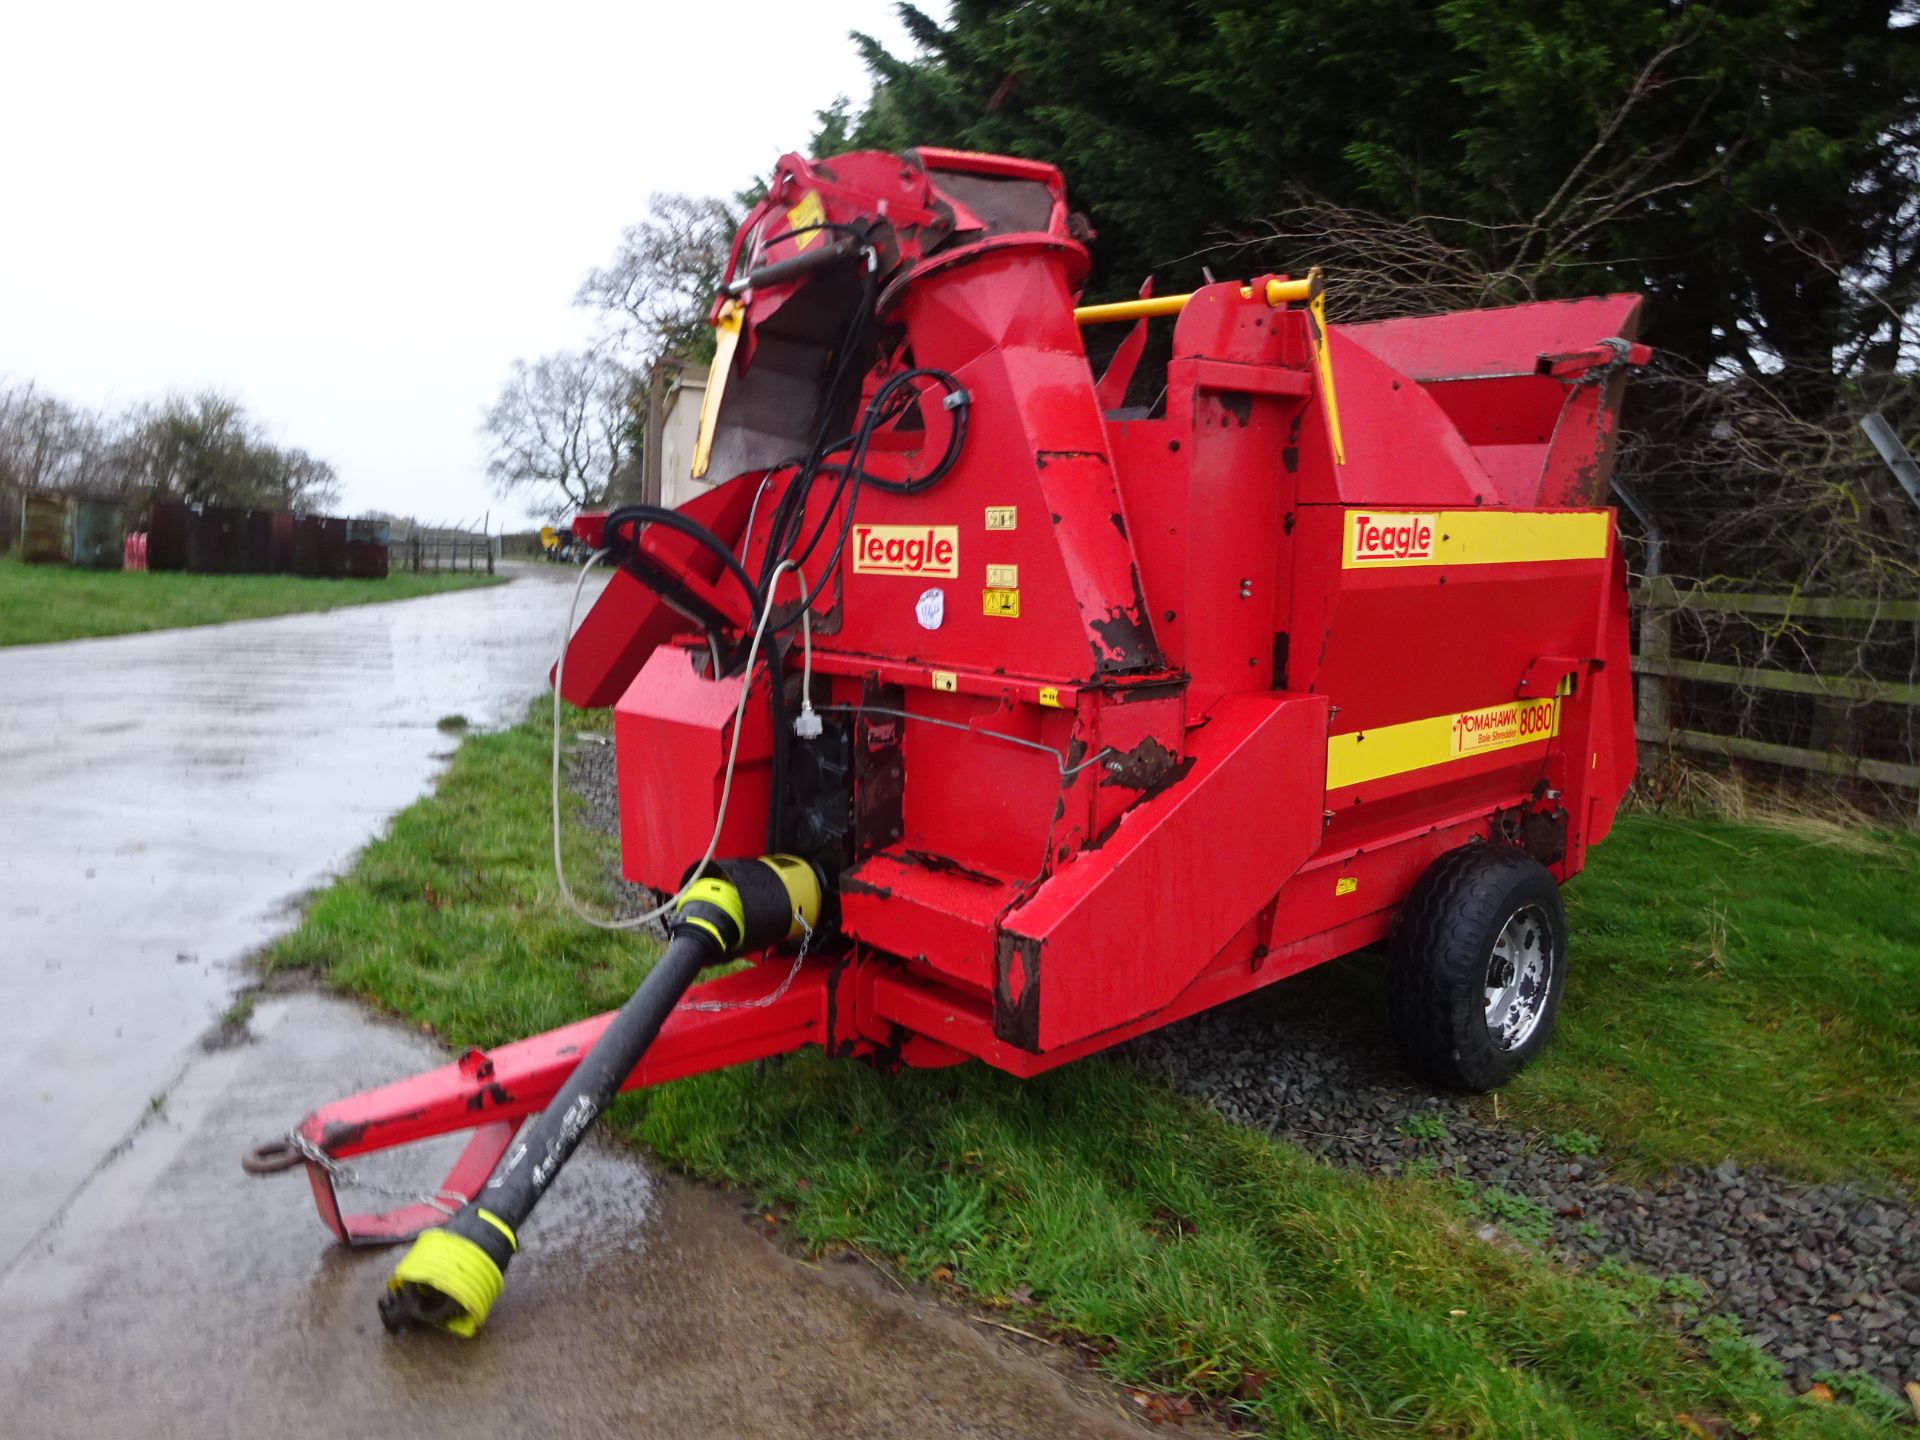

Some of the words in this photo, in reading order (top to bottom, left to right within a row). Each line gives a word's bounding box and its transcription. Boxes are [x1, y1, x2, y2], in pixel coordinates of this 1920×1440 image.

[856, 528, 953, 572] Teagle
[1356, 516, 1431, 559] Teagle
[1478, 732, 1492, 744] Bale
[1492, 729, 1517, 741] Shredder
[1519, 703, 1552, 736] 8080
